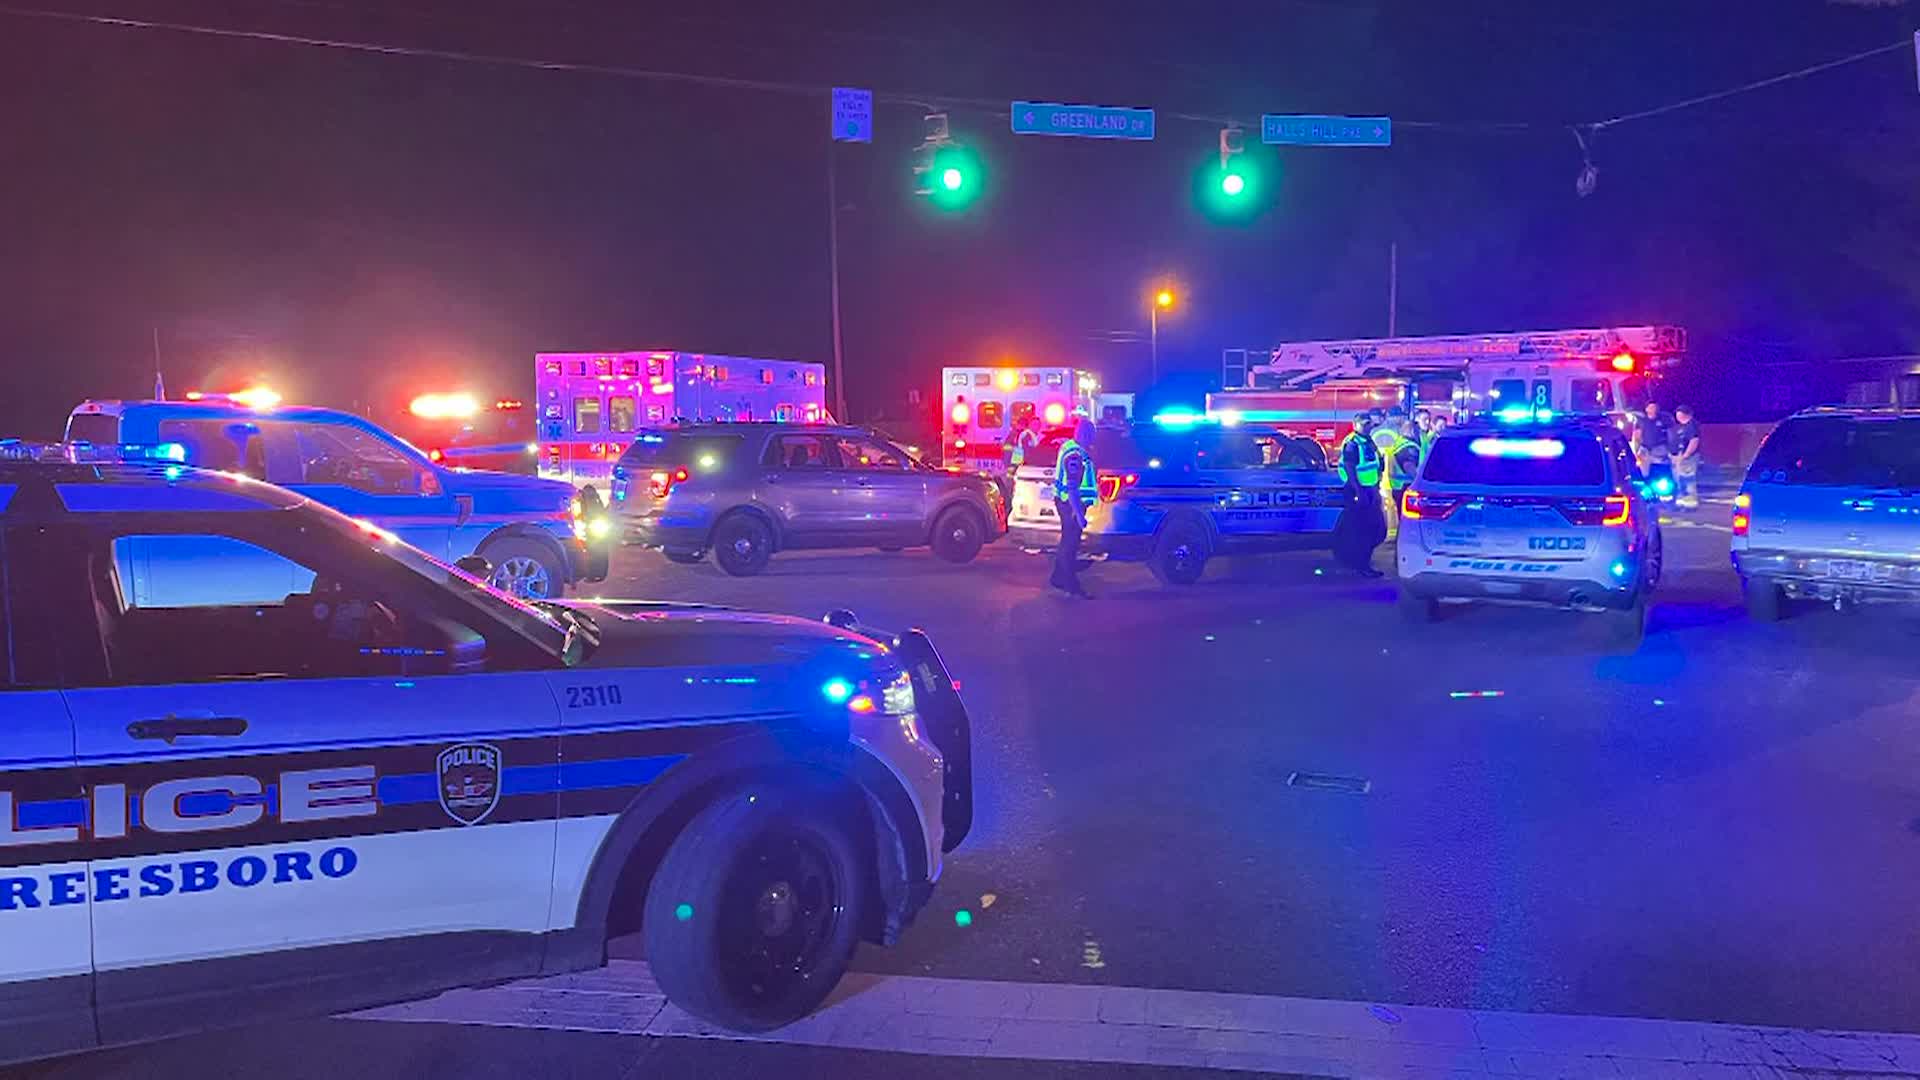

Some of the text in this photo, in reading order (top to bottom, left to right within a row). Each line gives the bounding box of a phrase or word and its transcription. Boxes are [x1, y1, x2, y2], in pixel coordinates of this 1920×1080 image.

[1051, 112, 1127, 130] GREENLAND
[1267, 123, 1305, 137] HALLS
[1311, 123, 1337, 138] HILL
[1536, 385, 1547, 406] 8
[566, 684, 622, 709] 2310
[442, 747, 496, 773] POLICE
[0, 846, 358, 910] REESBORO
